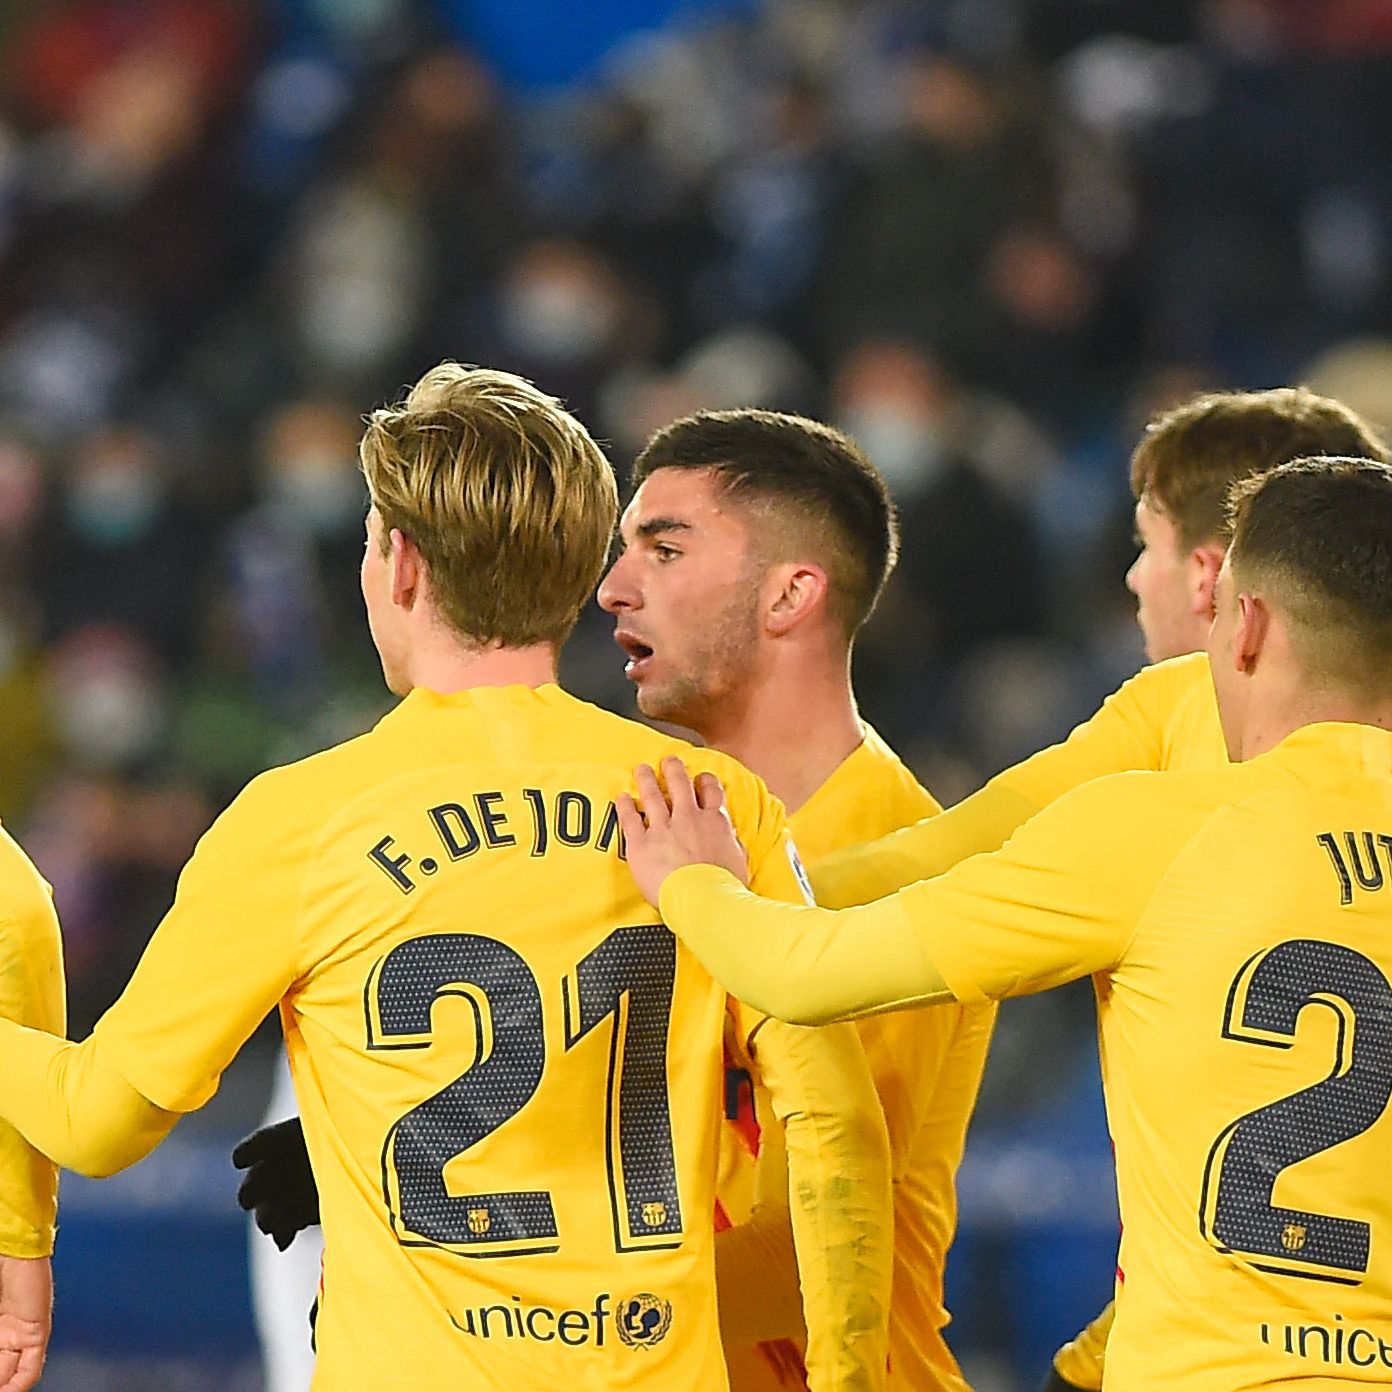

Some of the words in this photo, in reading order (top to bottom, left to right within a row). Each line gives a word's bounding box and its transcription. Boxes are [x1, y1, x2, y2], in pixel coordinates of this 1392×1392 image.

[368, 835, 437, 894] F.
[428, 792, 515, 862] DE
[523, 788, 628, 862] JON
[365, 924, 683, 1259] 21
[446, 1293, 610, 1347] unicef
